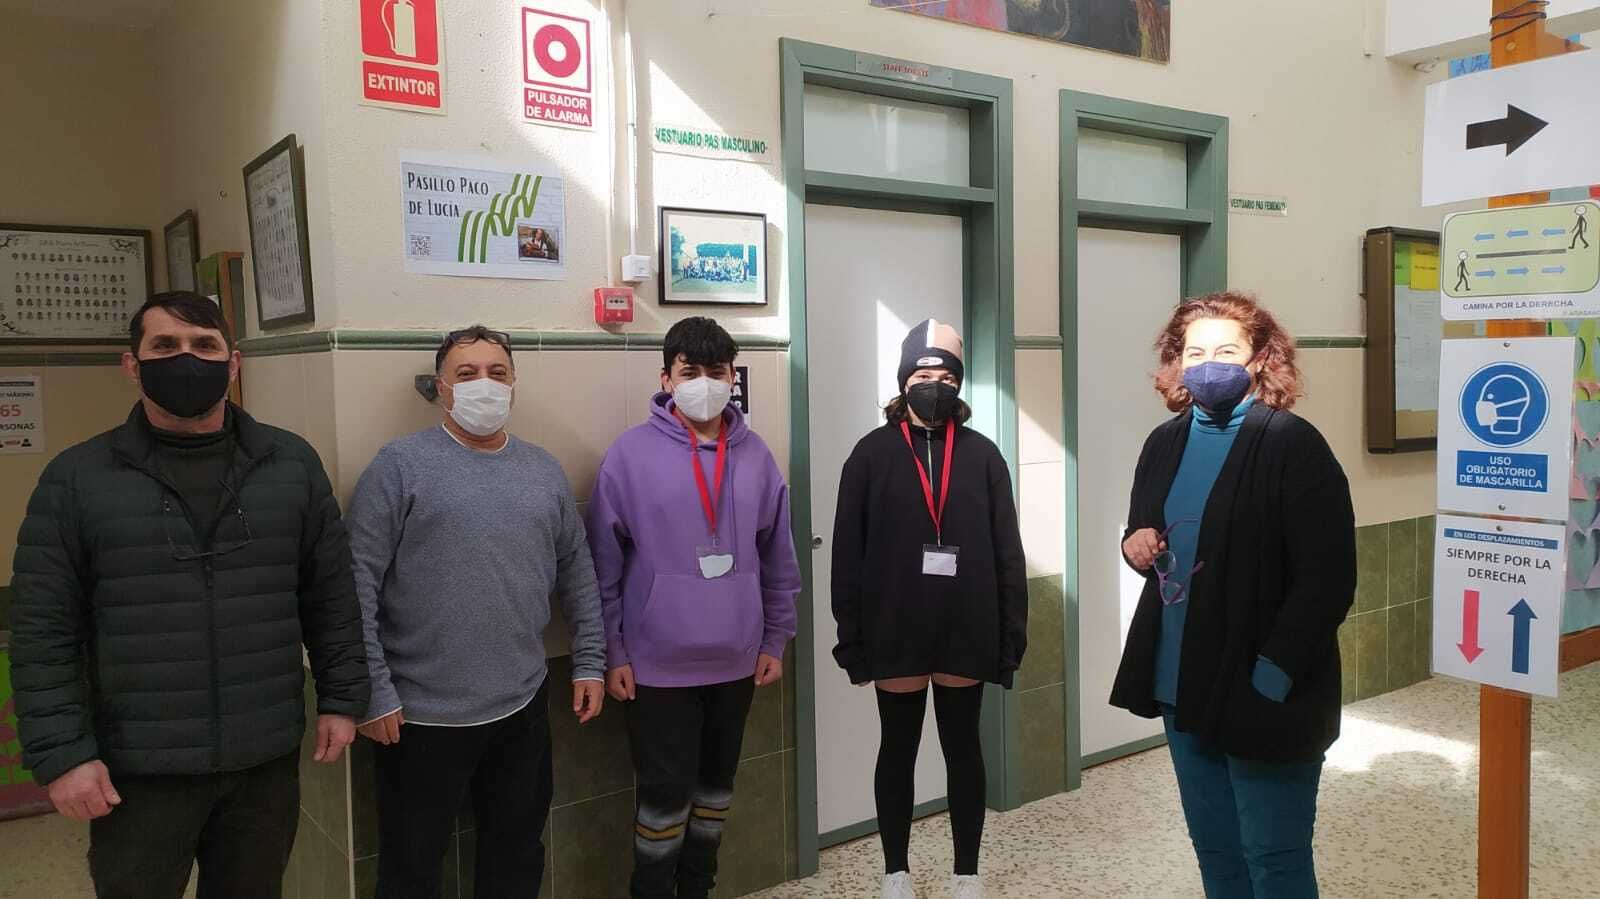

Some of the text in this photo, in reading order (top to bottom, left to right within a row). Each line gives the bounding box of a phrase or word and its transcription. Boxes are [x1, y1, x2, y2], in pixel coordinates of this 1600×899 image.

[367, 73, 436, 97] EXTINTOR
[527, 91, 588, 109] PULSADOR
[526, 106, 590, 125] DE ALARMA
[654, 127, 701, 147] VESTUARIO
[704, 134, 719, 149] PAS
[1231, 198, 1255, 209] VESTUARIO
[1462, 302, 1494, 311] CAMINA
[1496, 301, 1514, 309] POR
[1528, 299, 1574, 308] DERECHA
[1489, 455, 1512, 466] USO
[1466, 464, 1537, 478] OBLIGATORIO
[1459, 474, 1543, 489] DE MASCARILLA
[1477, 533, 1545, 547] DESPLAZAMIENTOS
[1446, 547, 1552, 570] SIEMPRE POR LA
[1467, 567, 1527, 585] DERECHA
